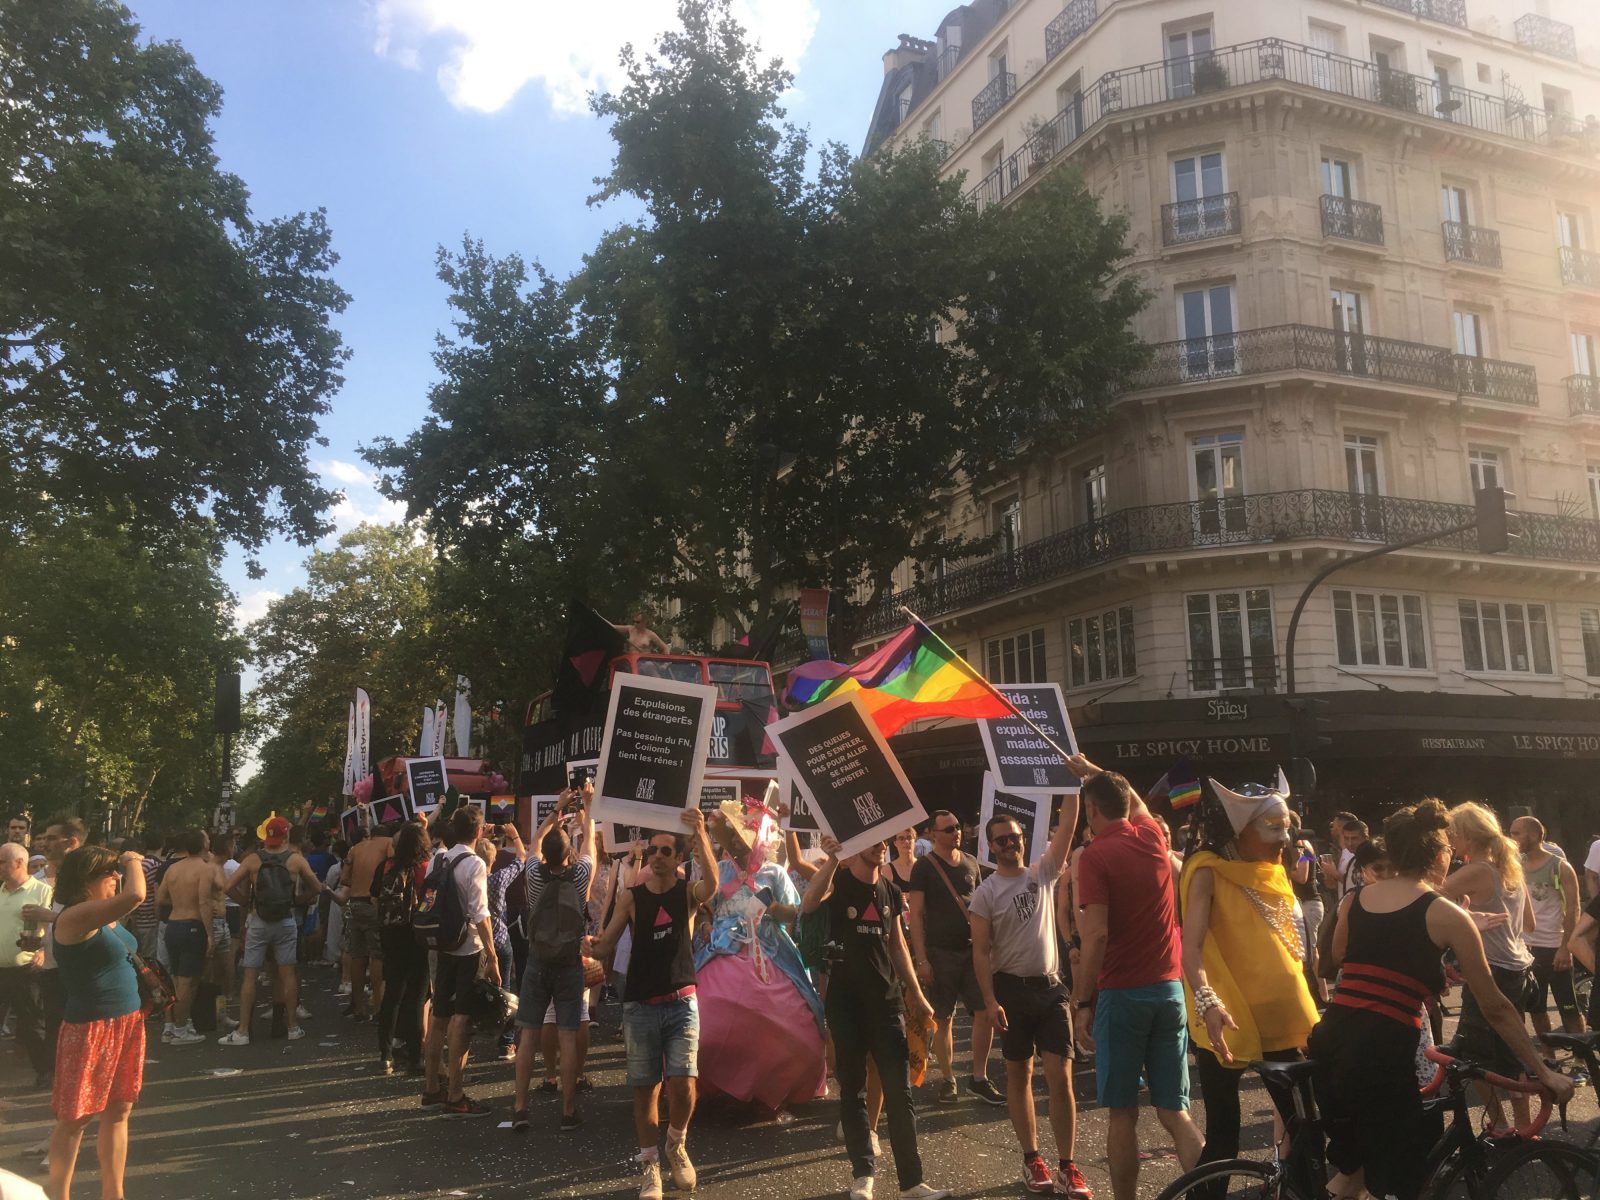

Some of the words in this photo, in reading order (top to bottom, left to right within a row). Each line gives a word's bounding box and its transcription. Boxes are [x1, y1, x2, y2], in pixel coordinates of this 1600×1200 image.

[634, 696, 686, 713] Expulsions
[1207, 699, 1248, 720] Spicy
[623, 707, 640, 718] des
[642, 710, 693, 726] étrangerEs
[713, 716, 726, 737] UP
[996, 723, 1059, 737] expulsEs,
[616, 728, 632, 739] Pas
[634, 730, 663, 743] besoin
[664, 735, 676, 745] du
[807, 742, 824, 755] DES
[823, 730, 852, 747] QUEUES
[1006, 739, 1051, 750] malade
[1421, 737, 1486, 750] RESTAURANT
[1512, 735, 1533, 750] LE
[1535, 735, 1575, 751] SPICY
[1578, 736, 1600, 751] HO
[618, 750, 638, 761] tient
[639, 753, 652, 763] les
[708, 737, 728, 758] RIS
[1115, 743, 1141, 759] LE
[1146, 740, 1201, 757] SPICY
[1206, 737, 1271, 754] HOME
[805, 754, 827, 767] POUR
[811, 764, 827, 776] PAS
[826, 755, 847, 769] POUR
[846, 744, 869, 760] ALLER
[829, 769, 842, 778] SE
[841, 759, 862, 774] FAIRE
[1000, 753, 1065, 766] assassinéE
[831, 769, 865, 789] DÉPISTER
[852, 794, 866, 811] ACT
[863, 791, 876, 807] UP
[857, 803, 886, 826] PARIS
[1016, 906, 1034, 921] PAR
